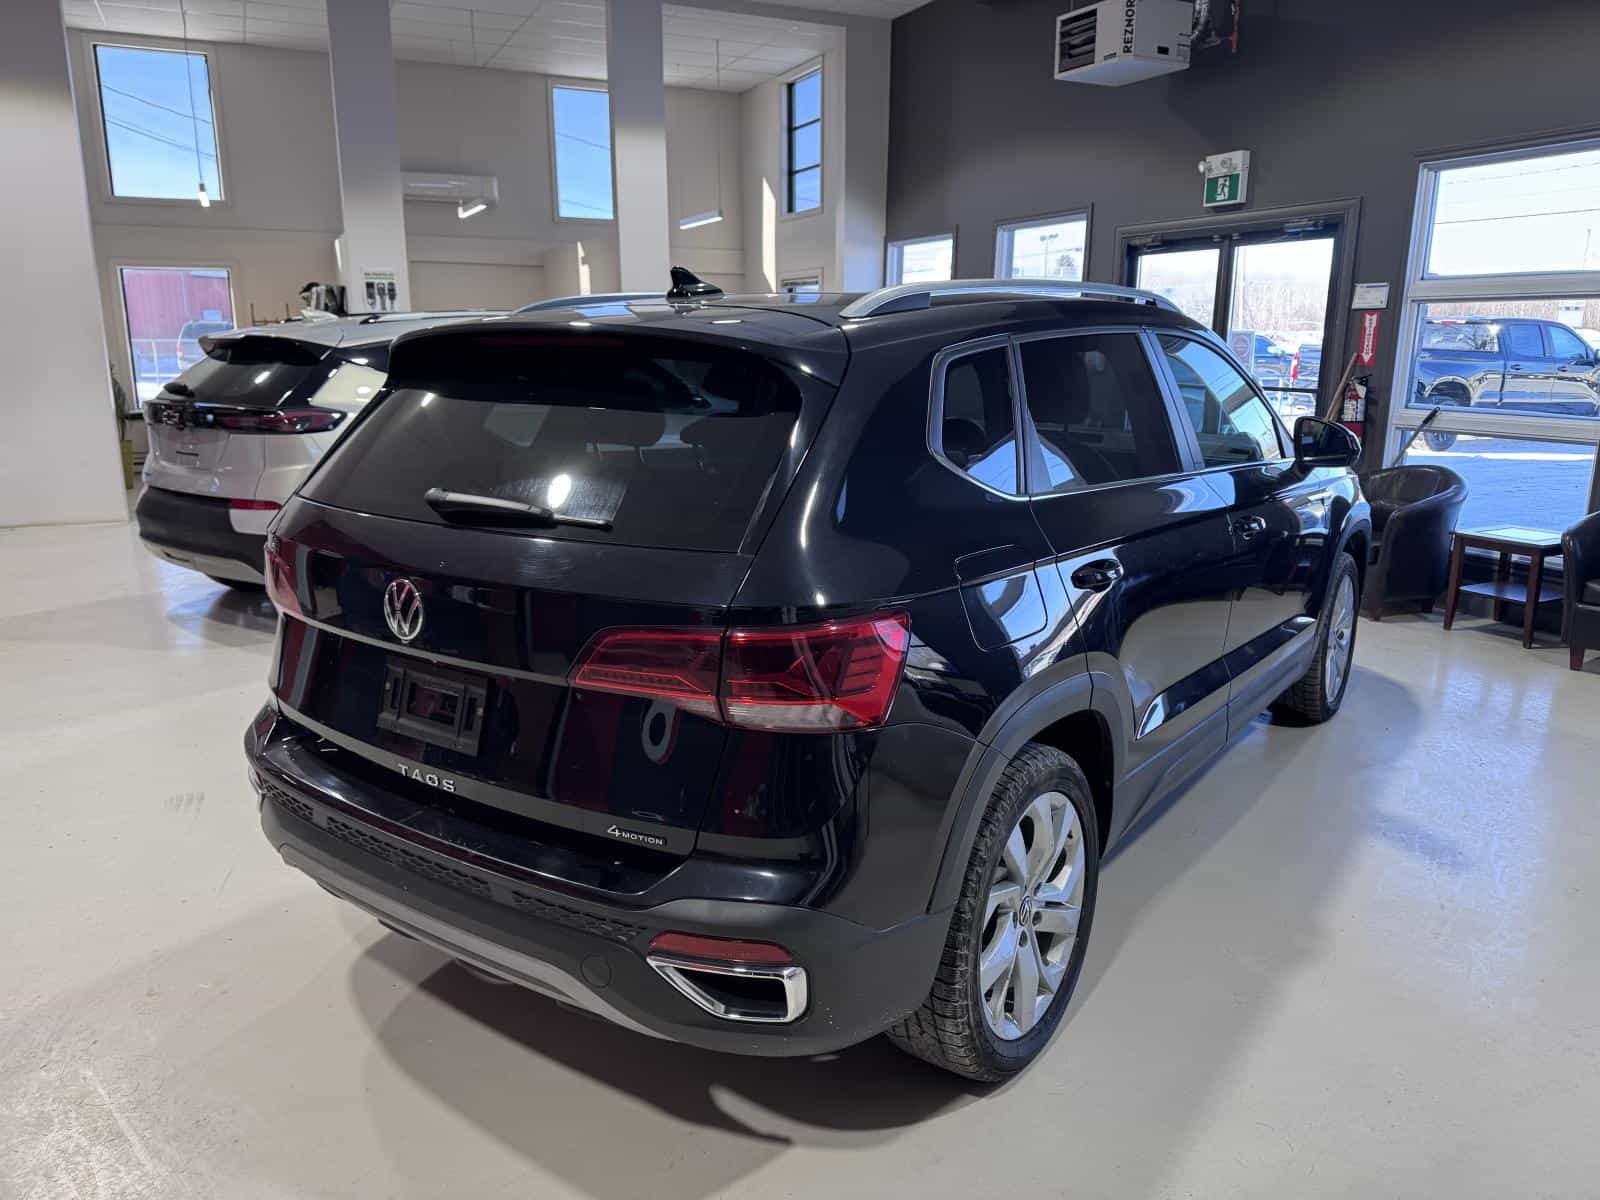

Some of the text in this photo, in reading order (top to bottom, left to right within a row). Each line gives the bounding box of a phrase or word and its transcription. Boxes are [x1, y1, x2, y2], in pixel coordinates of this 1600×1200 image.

[1122, 0, 1136, 54] REZNOR
[398, 763, 457, 793] TAOS
[607, 824, 664, 846] 4MOTION
